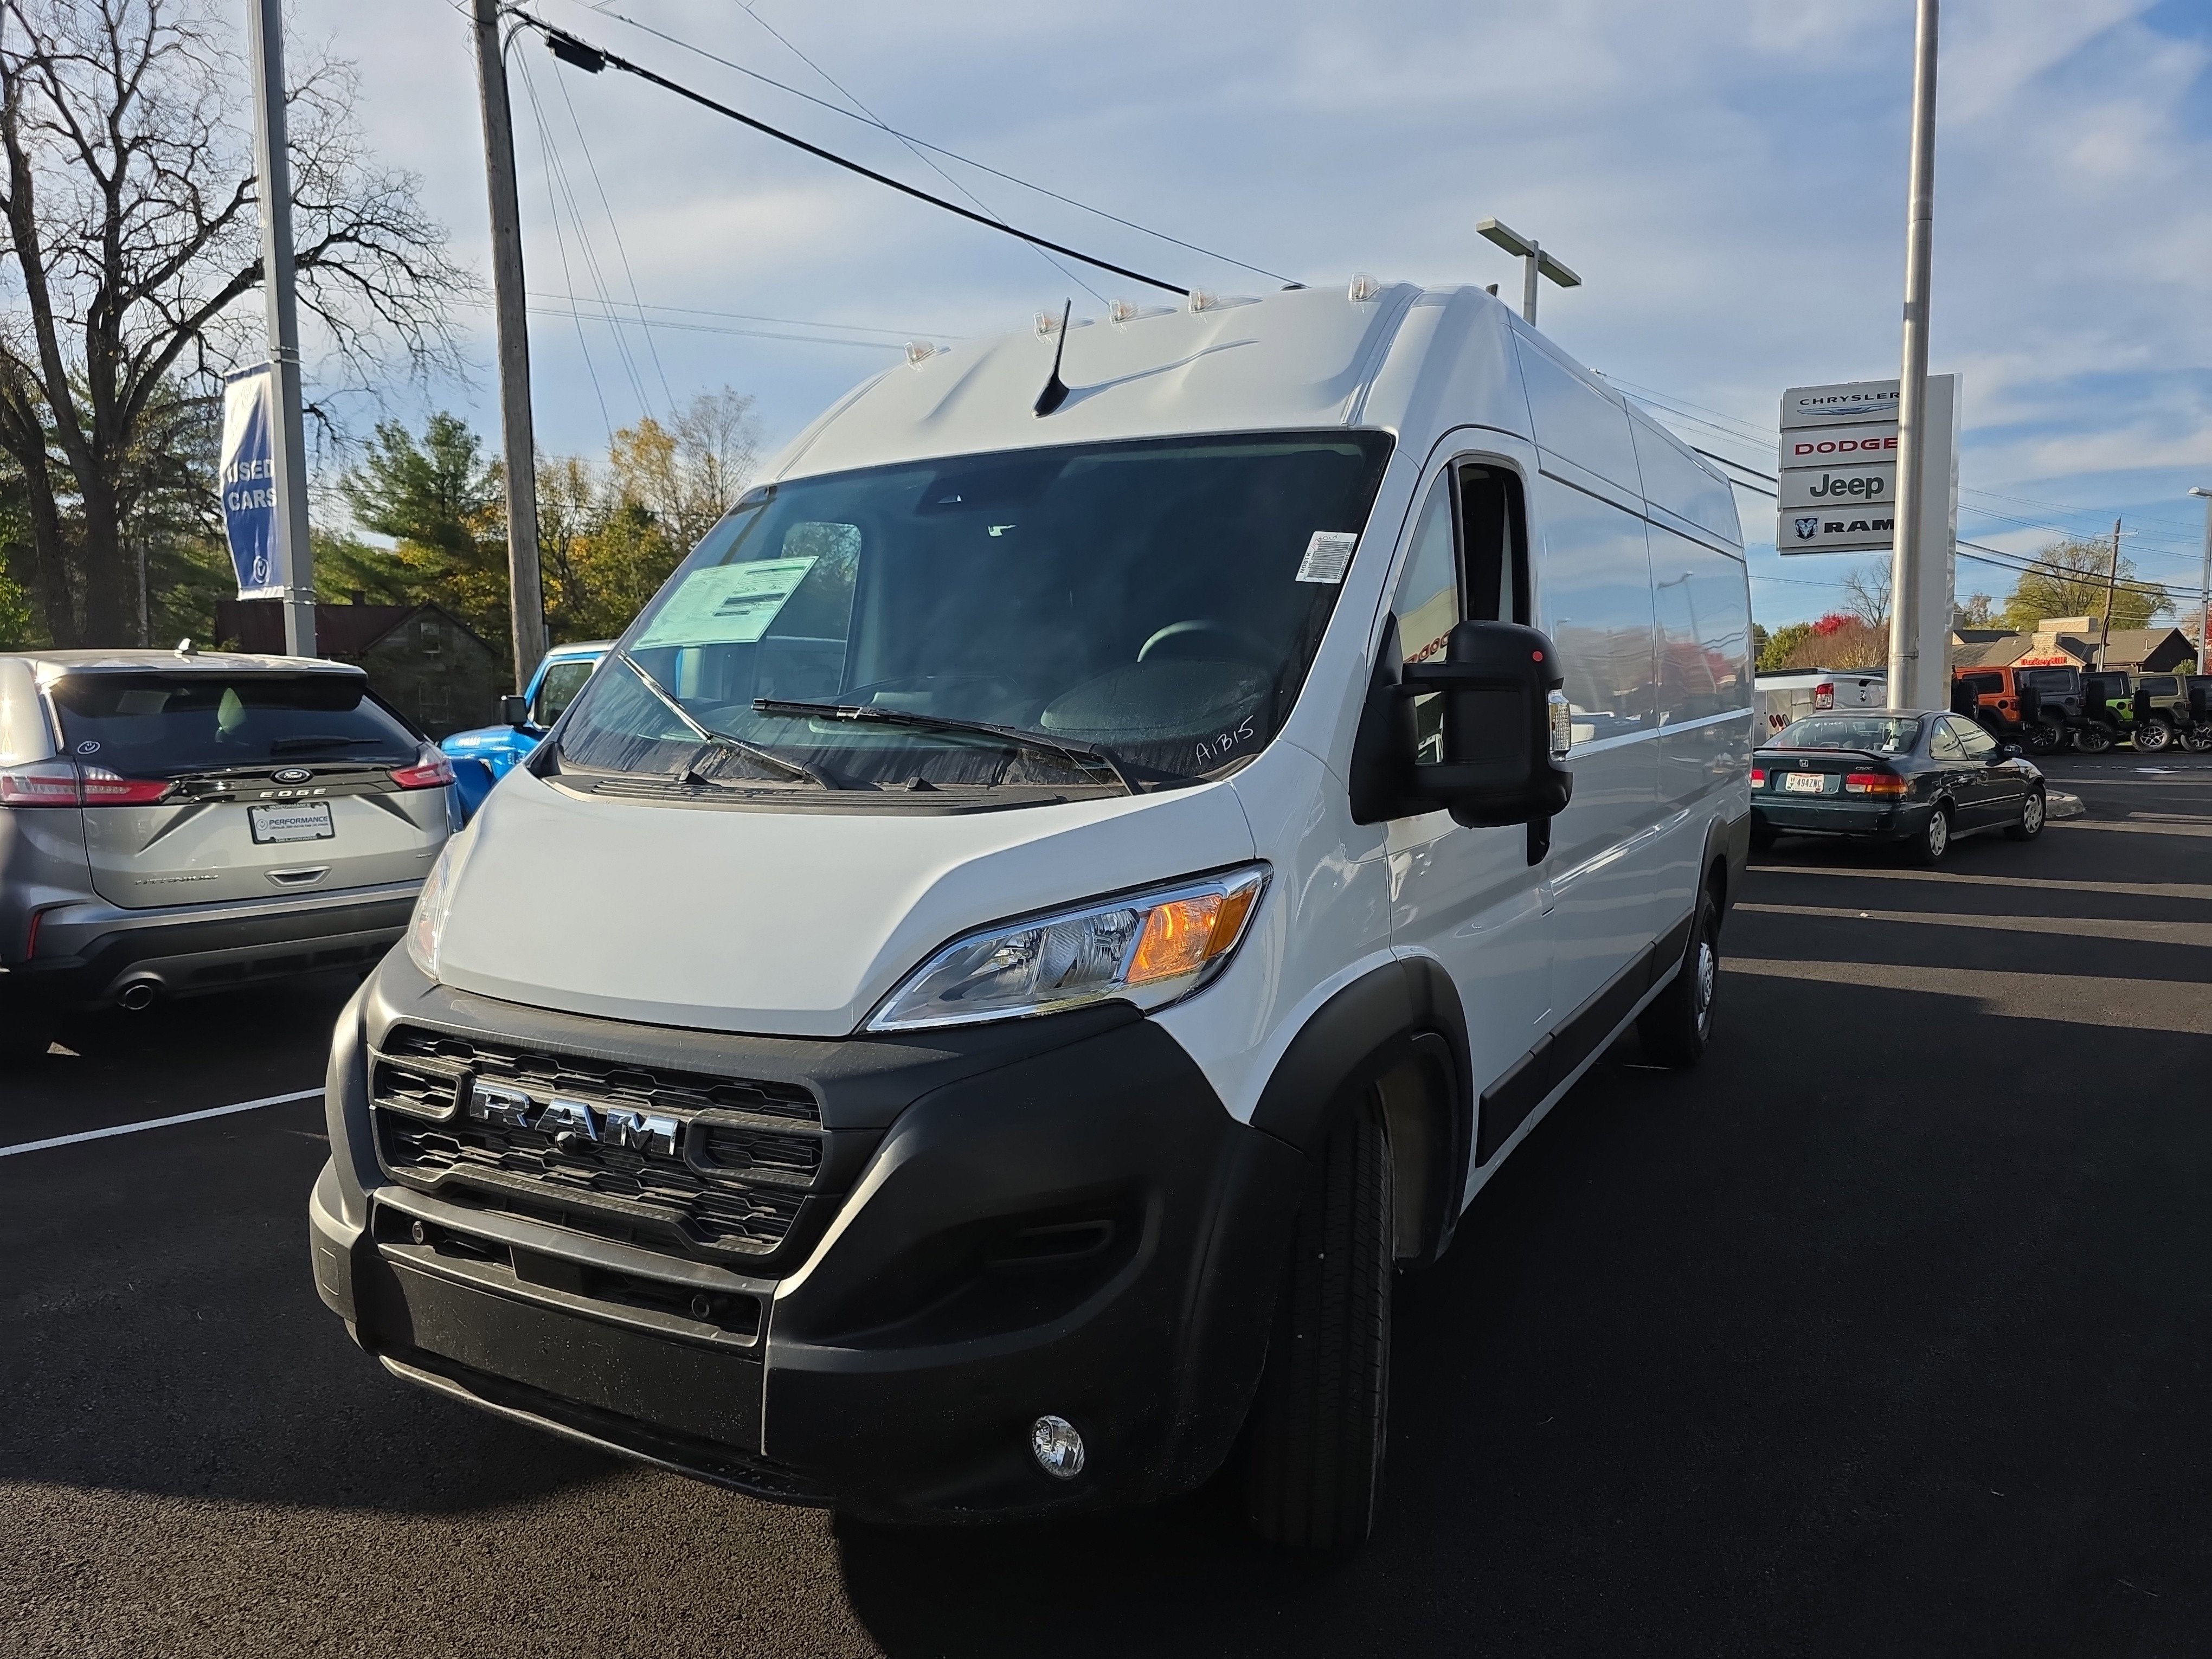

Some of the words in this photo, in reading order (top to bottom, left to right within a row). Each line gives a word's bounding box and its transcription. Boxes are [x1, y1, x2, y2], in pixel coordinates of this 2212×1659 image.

[1799, 392, 1900, 406] CHRYSLER
[1795, 437, 1898, 455] DODGE
[227, 459, 274, 483] USED
[1810, 474, 1885, 499] Jeep
[228, 488, 277, 511] CARS
[1824, 519, 1894, 533] RAM
[1300, 552, 1312, 574] NOSTK
[1797, 778, 1822, 788] 494ZNC
[260, 788, 327, 798] EDGE
[269, 816, 328, 826] PERFORMANCE
[470, 1083, 679, 1156] RAM
